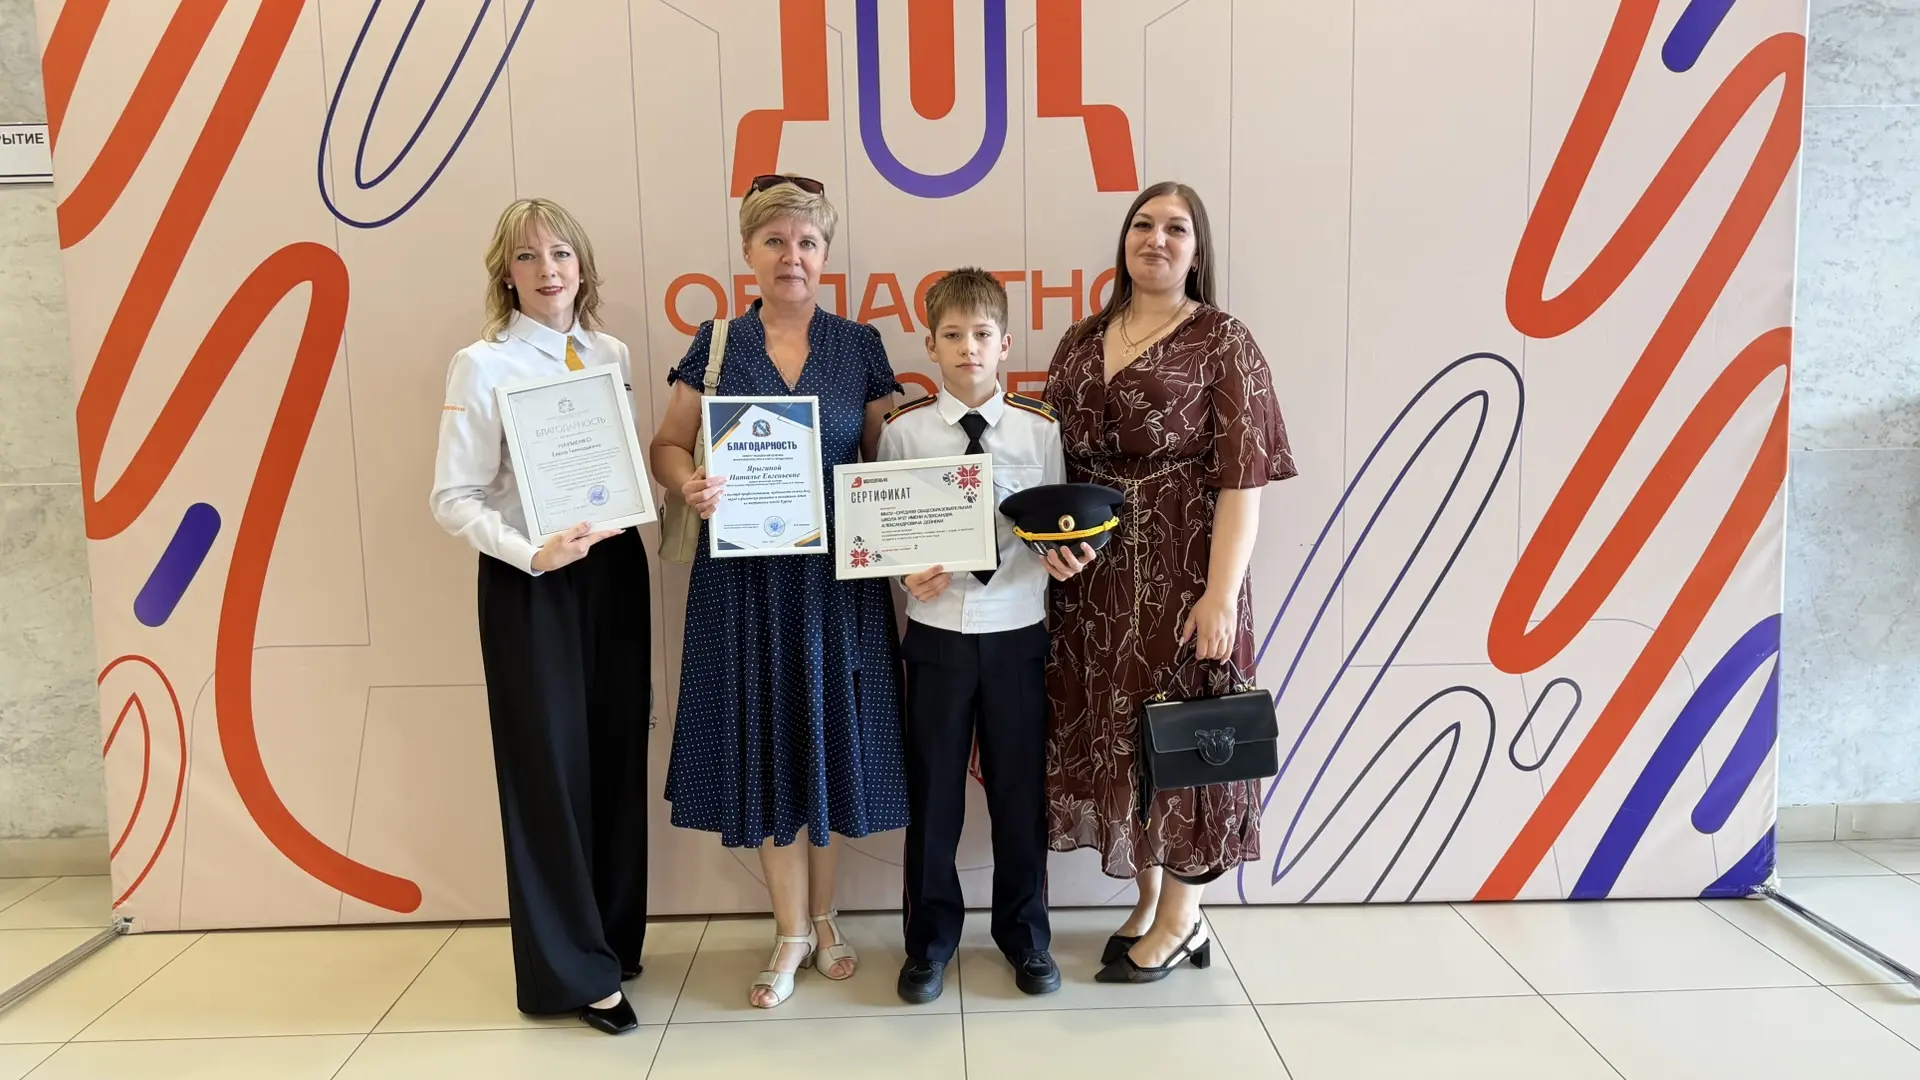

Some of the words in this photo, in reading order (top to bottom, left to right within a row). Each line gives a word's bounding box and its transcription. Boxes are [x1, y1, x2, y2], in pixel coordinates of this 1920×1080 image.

[0, 133, 44, 145] ЫТИЕ
[535, 416, 606, 438] БЛАГОДАРНОСТЬ
[727, 441, 798, 452] БЛАГОДАРНОСТЬ
[763, 472, 801, 480] Евгеньевне
[851, 487, 911, 504] СЕРТИФИКАТ
